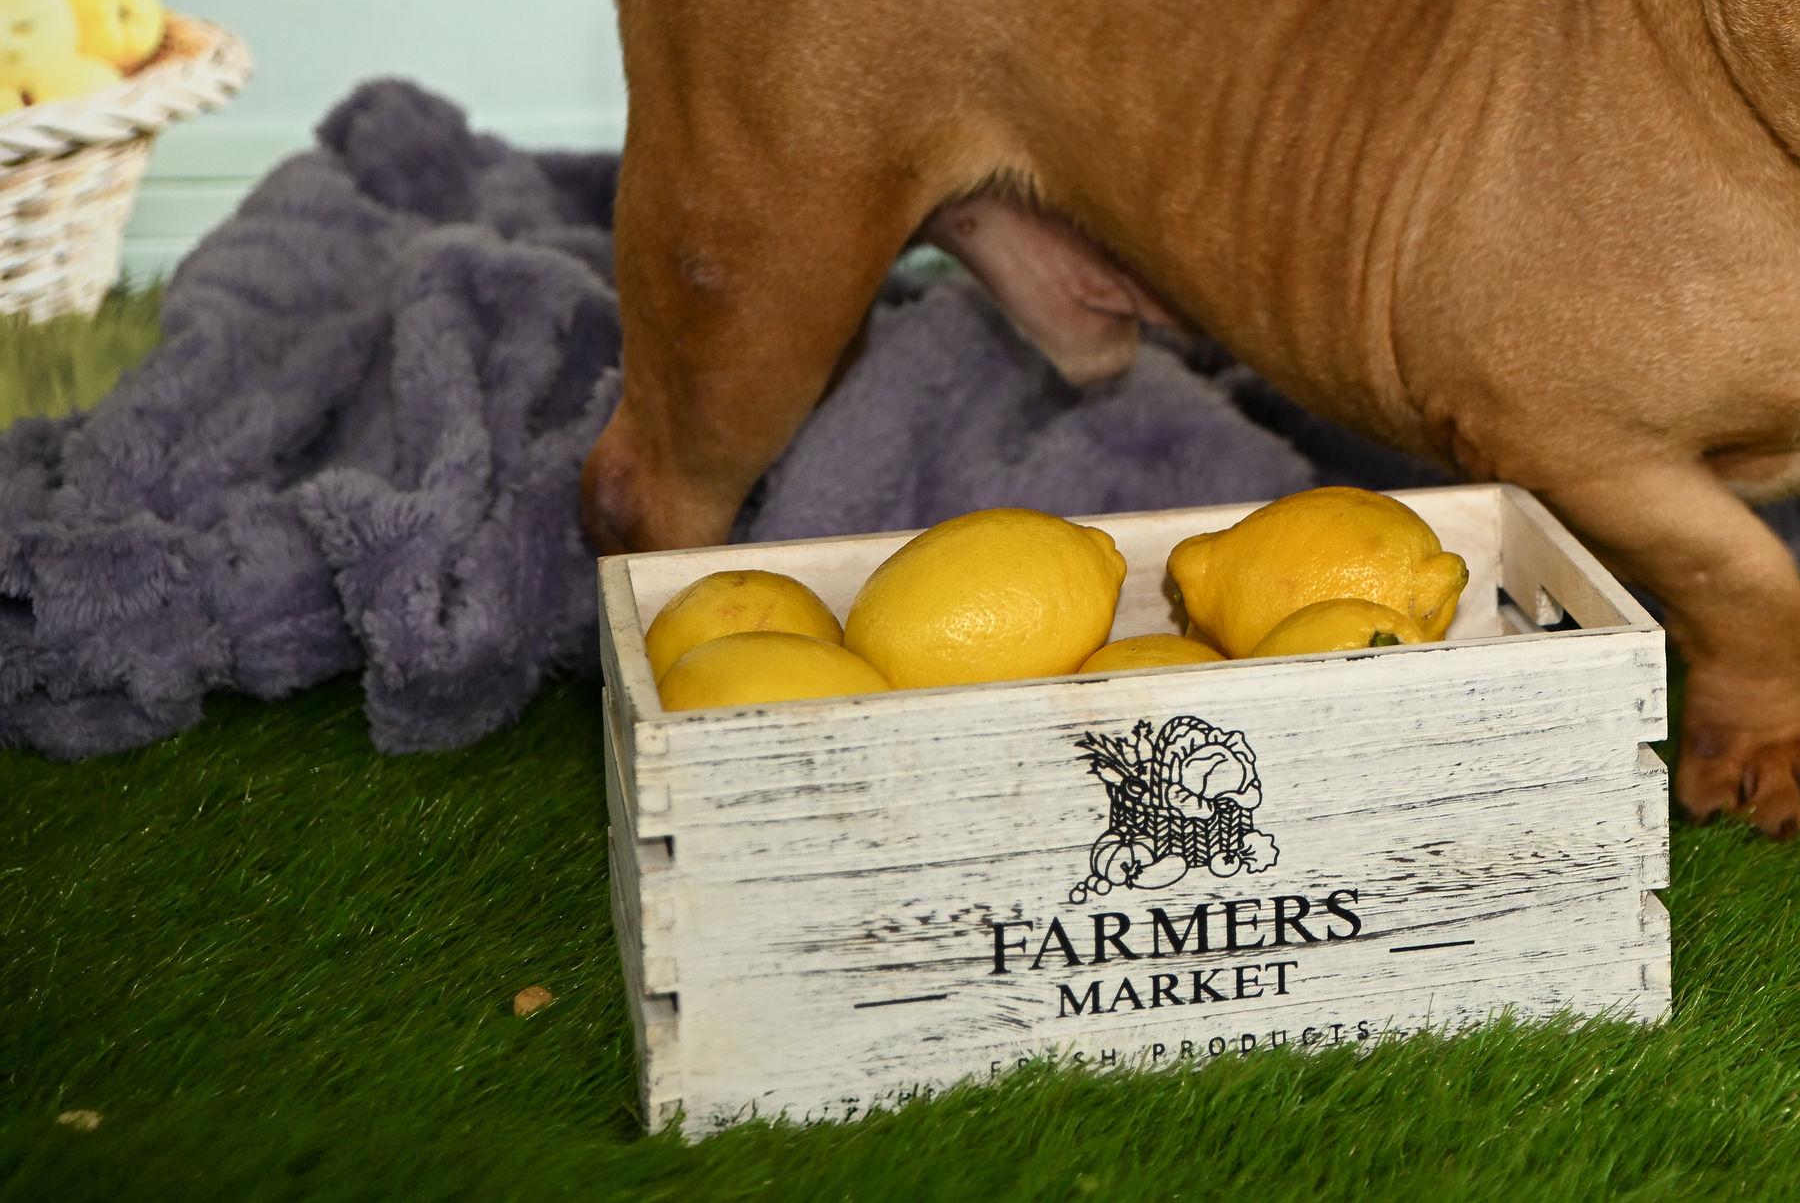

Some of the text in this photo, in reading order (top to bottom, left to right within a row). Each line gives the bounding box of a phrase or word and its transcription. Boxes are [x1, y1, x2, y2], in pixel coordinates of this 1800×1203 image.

[990, 888, 1363, 975] FARMERS
[1055, 961, 1299, 1018] MARKET
[990, 1020, 1368, 1081] FSH PRODUCTS
